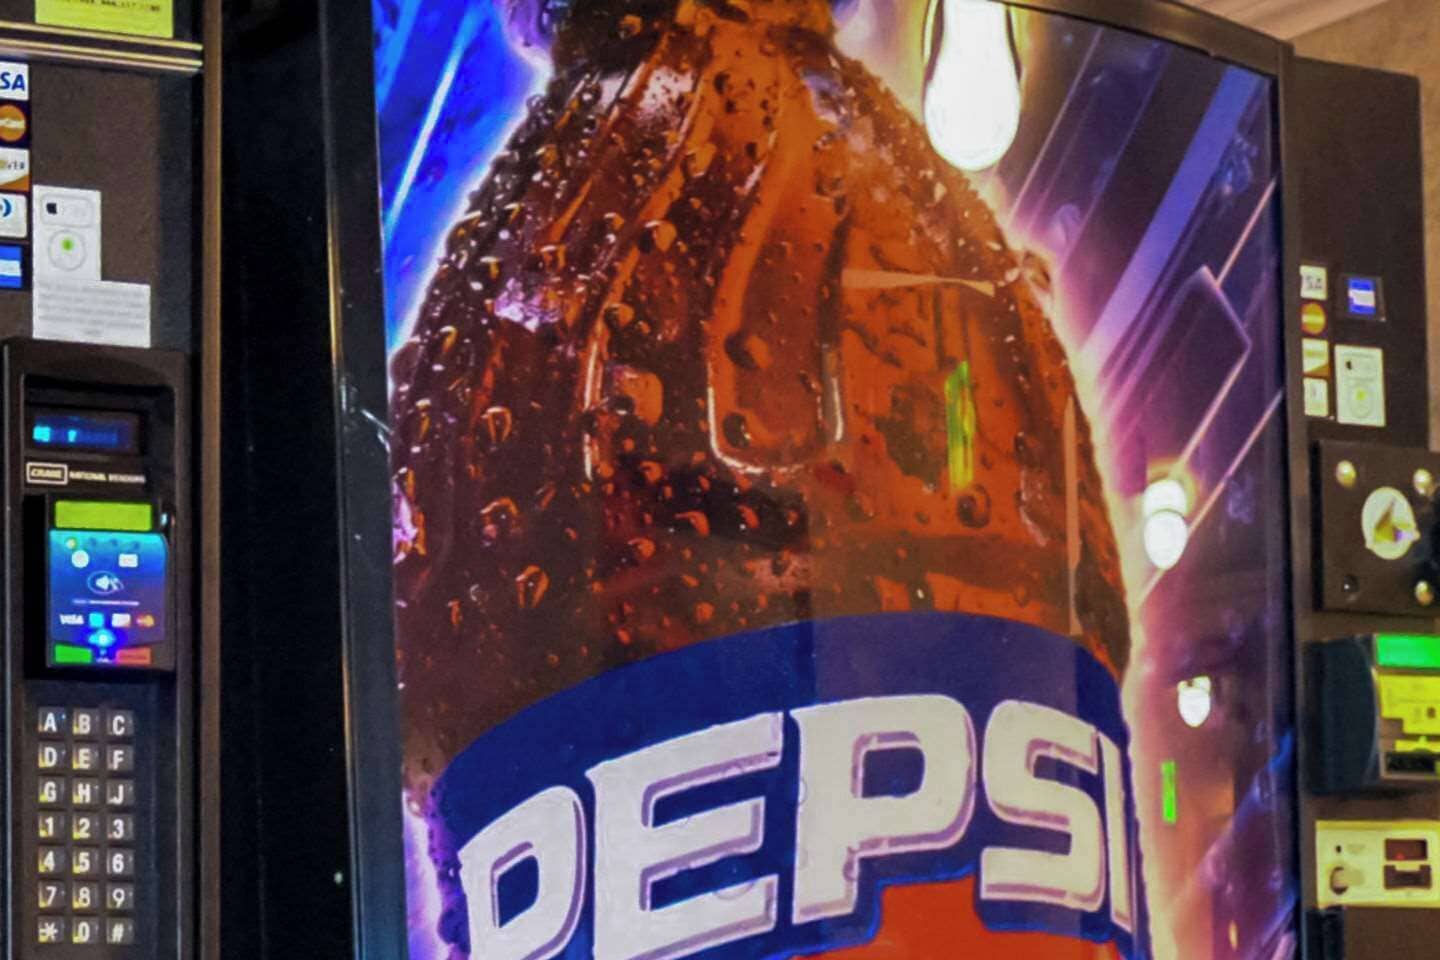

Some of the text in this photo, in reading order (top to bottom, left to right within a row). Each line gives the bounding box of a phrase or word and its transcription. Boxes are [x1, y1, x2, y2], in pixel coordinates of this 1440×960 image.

[44, 713, 125, 735] A B C
[45, 748, 123, 770] D E F
[44, 783, 123, 804] G H J
[46, 818, 123, 838] 1 2 3
[44, 852, 123, 872] 4 5 6
[46, 887, 124, 907] 7 8 9
[79, 923, 89, 941] 0
